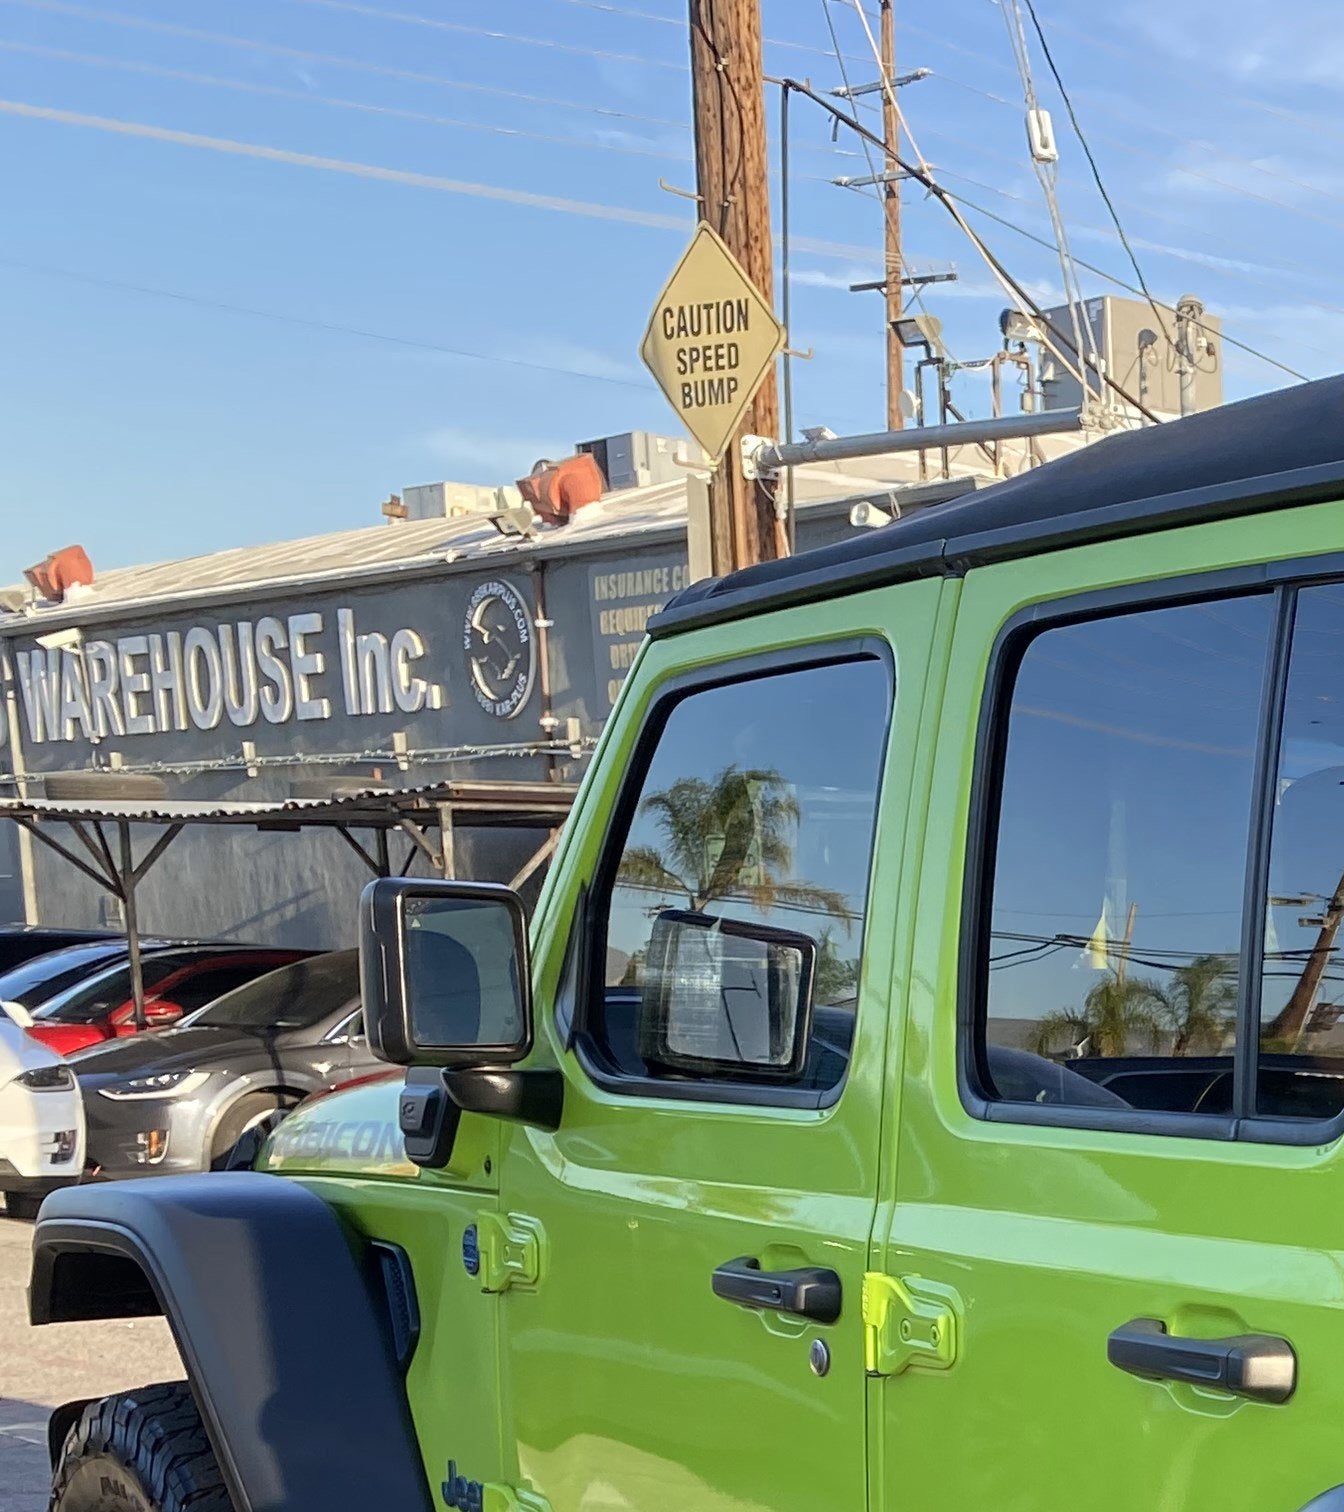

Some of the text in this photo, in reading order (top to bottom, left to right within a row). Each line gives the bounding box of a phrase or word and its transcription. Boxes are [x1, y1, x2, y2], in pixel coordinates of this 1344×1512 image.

[662, 298, 749, 340] CAUTION
[677, 342, 739, 375] SPEED
[681, 377, 738, 409] BUMP
[594, 567, 669, 601] INSURANCE
[16, 612, 332, 743] WAREHOUSE
[337, 608, 442, 716] Inc.
